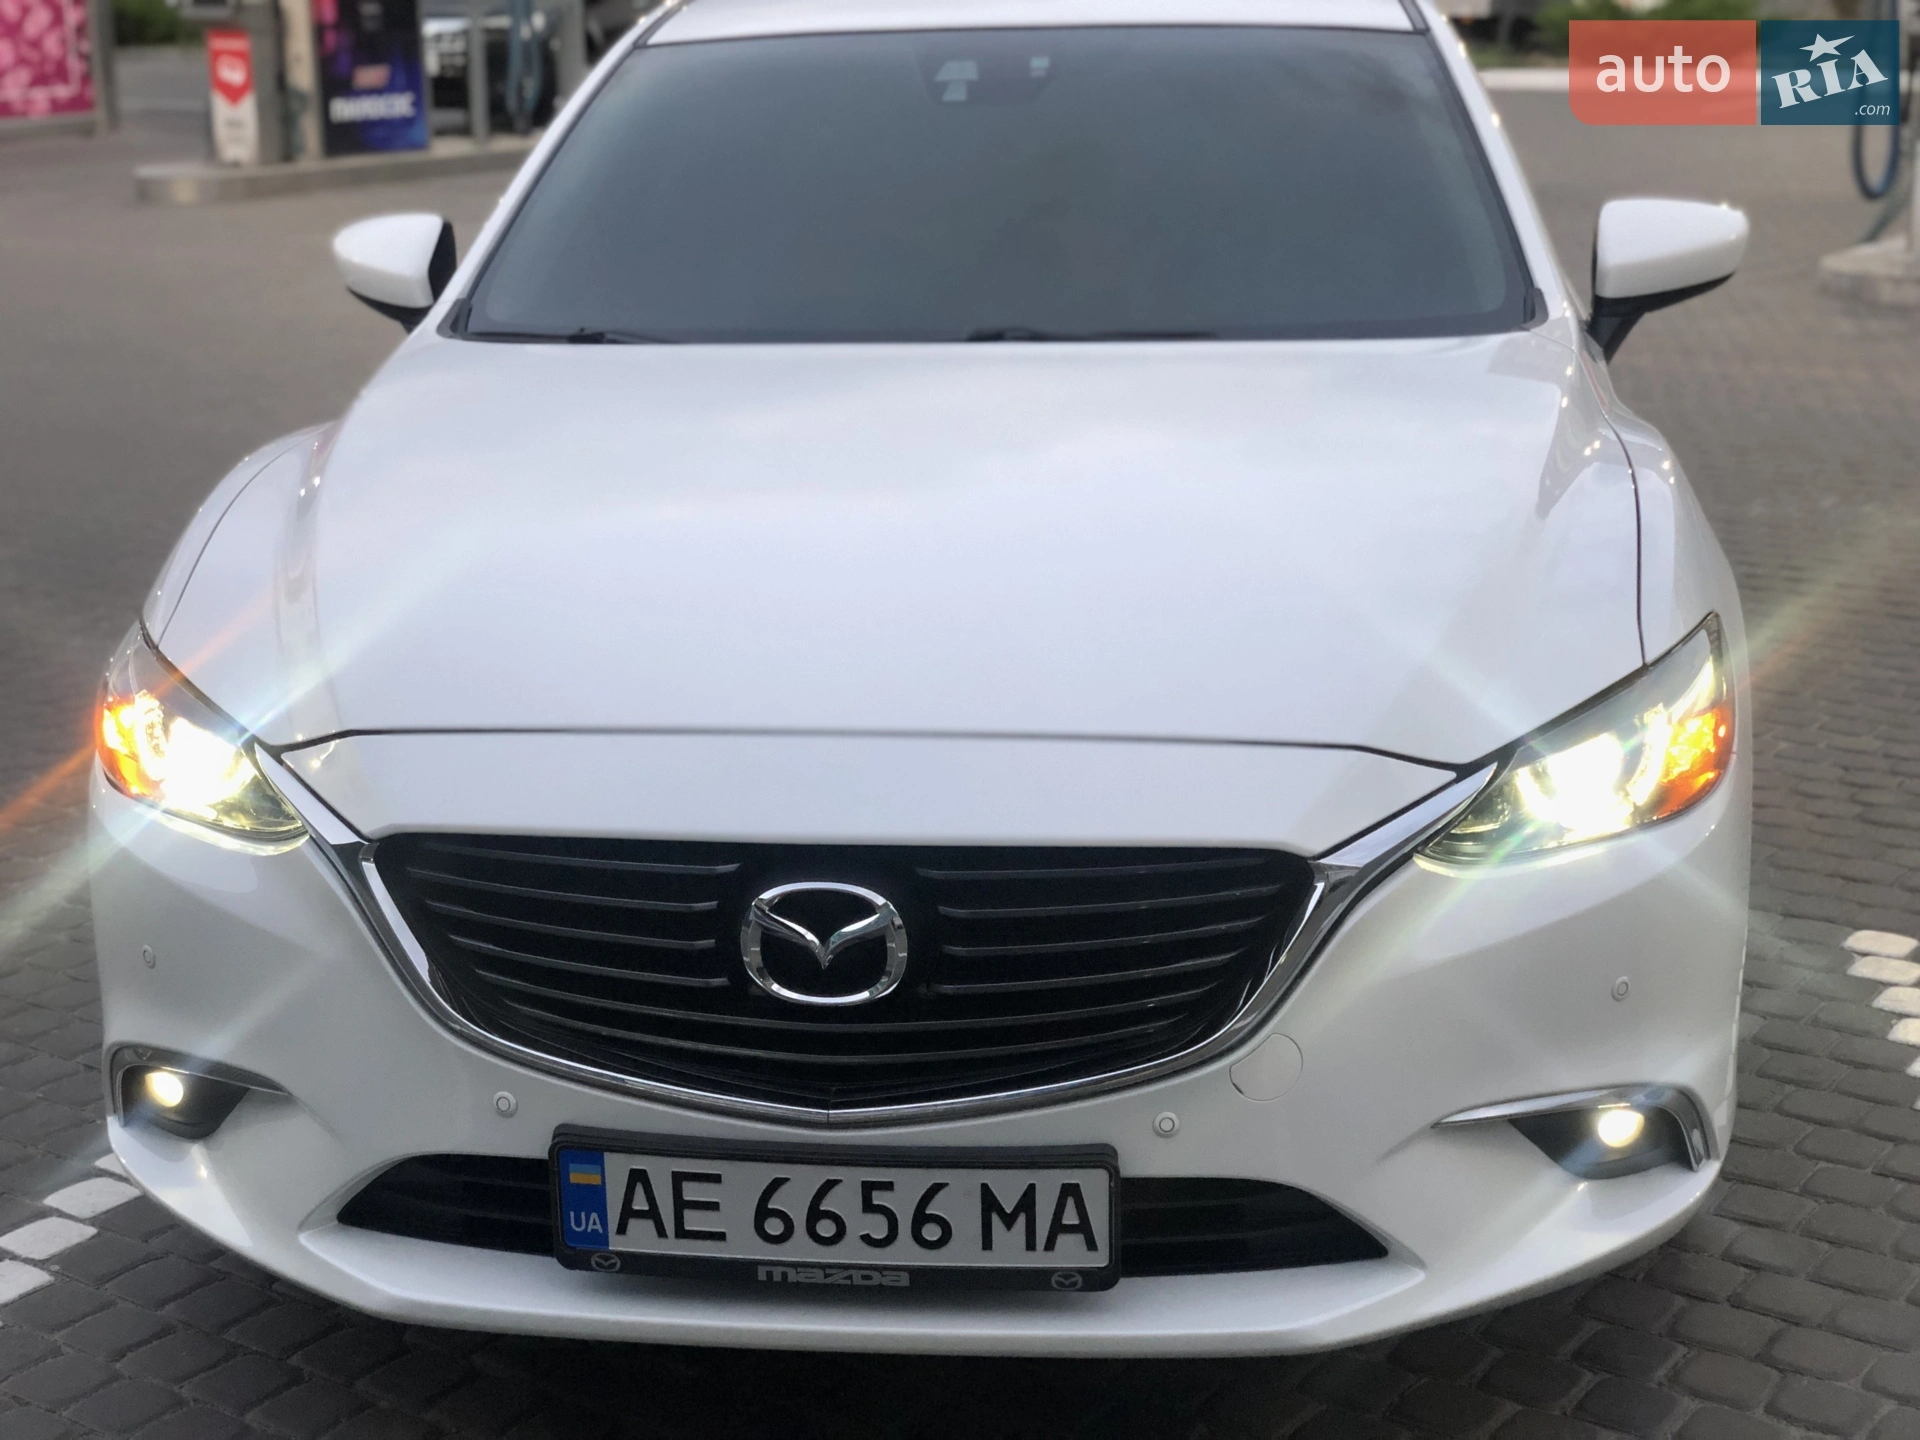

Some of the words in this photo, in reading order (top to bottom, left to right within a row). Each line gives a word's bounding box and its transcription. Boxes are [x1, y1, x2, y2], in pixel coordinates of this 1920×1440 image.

[569, 1210, 603, 1234] UA
[615, 1166, 727, 1242] AE
[753, 1176, 953, 1251] 6656
[980, 1182, 1099, 1252] MA
